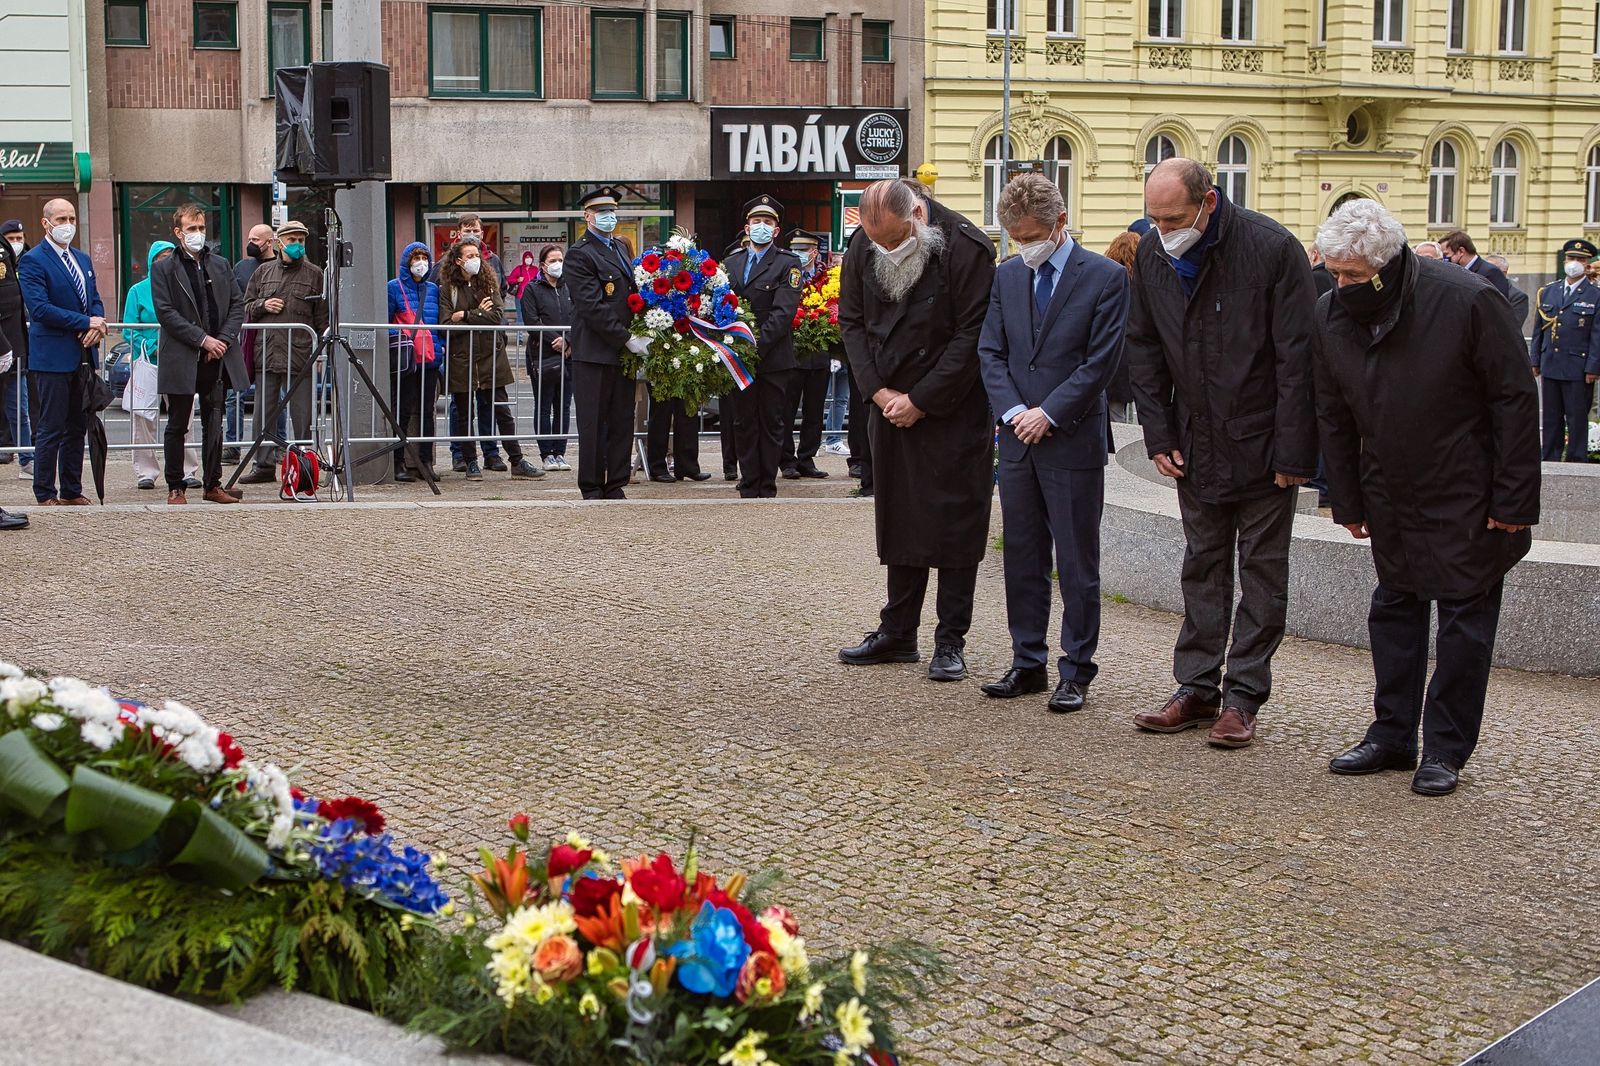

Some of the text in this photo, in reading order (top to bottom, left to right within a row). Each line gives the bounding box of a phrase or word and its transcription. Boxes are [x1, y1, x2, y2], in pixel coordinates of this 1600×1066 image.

[868, 127, 895, 138] LUCKY
[722, 114, 850, 172] TABÁK
[866, 137, 895, 148] STRIKE
